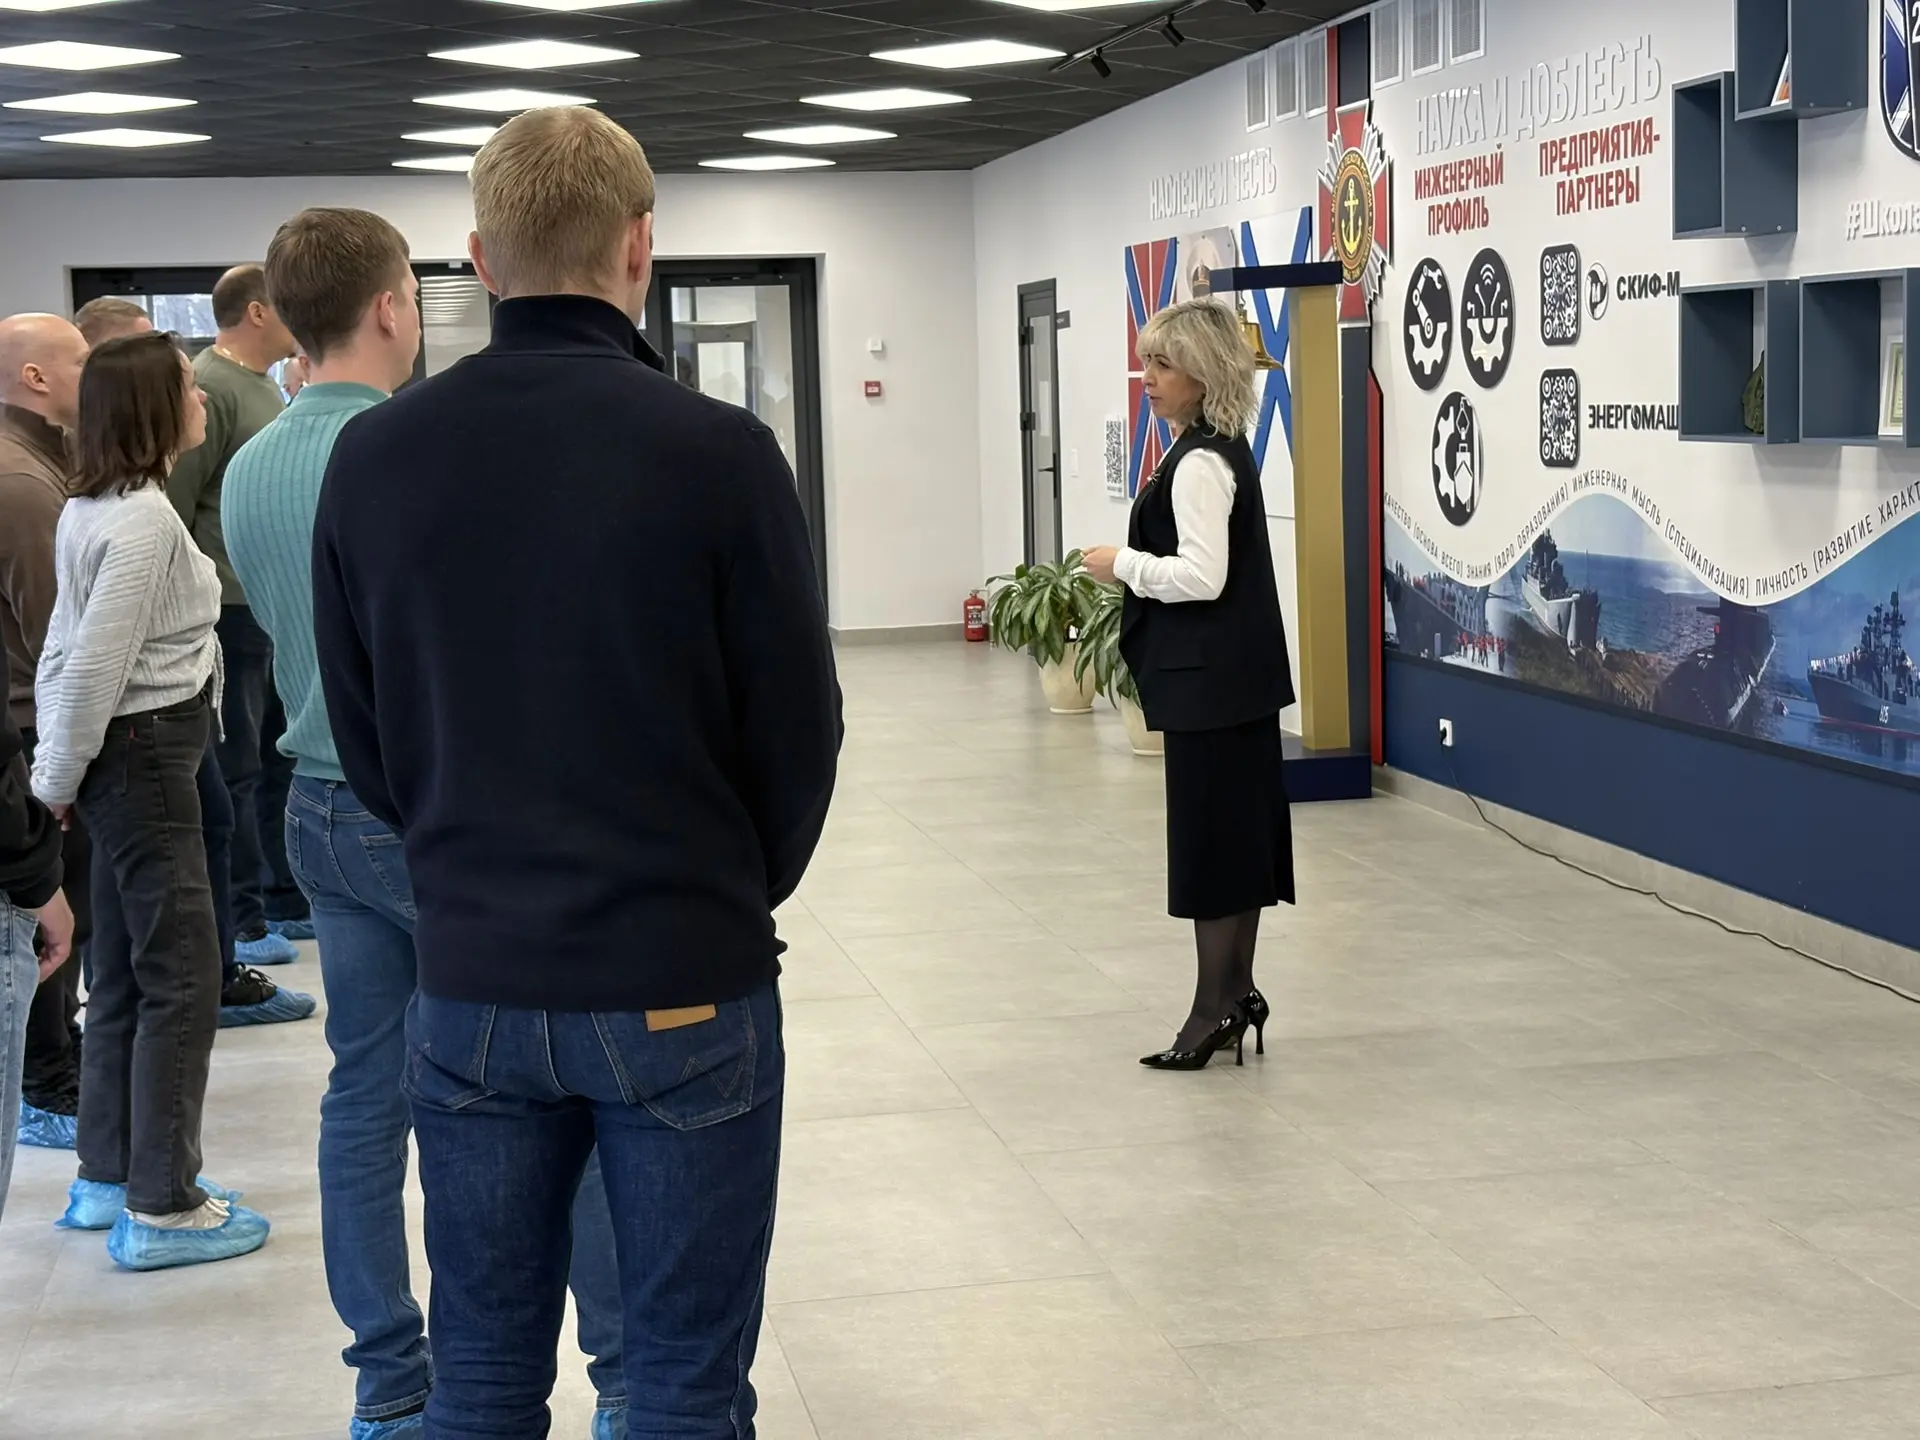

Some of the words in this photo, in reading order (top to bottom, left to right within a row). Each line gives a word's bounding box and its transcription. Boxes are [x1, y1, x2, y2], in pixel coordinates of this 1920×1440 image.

[1416, 83, 1487, 155] НАУКА
[1493, 76, 1509, 138] И
[1514, 34, 1662, 142] ДОБЛЕСТЬ
[1414, 143, 1504, 201] ИНЖЕНЕРНЫЙ
[1539, 116, 1661, 177] ПРЕДПРИЯТИЯ-
[1151, 162, 1217, 221] НАСЛЕДИЕ
[1219, 157, 1229, 206] И
[1230, 147, 1278, 202] ЧЕСТЬ
[1556, 165, 1641, 216] ПАРТНЕРЫ
[1427, 196, 1489, 236] ПРОФИЛЬ
[1616, 270, 1681, 301] СКИФ-М
[1383, 491, 1412, 530] КАЧЕСТВО
[1466, 562, 1492, 580] ЗНАНИЯ
[1516, 482, 1569, 549] ОБРАЗОВАНИЯ)
[1572, 469, 1628, 494] ИНЖЕНЕРНАЯ
[1631, 486, 1661, 526] МЫСЛЬ
[1664, 518, 1750, 599] (СПЕЦИАЛИЗАЦИЯ)
[1755, 561, 1808, 597] ЛИЧНОСТЬ
[1812, 514, 1873, 574] (РАЗВИТИЕ
[1877, 480, 1920, 525] ХАРАКТ
